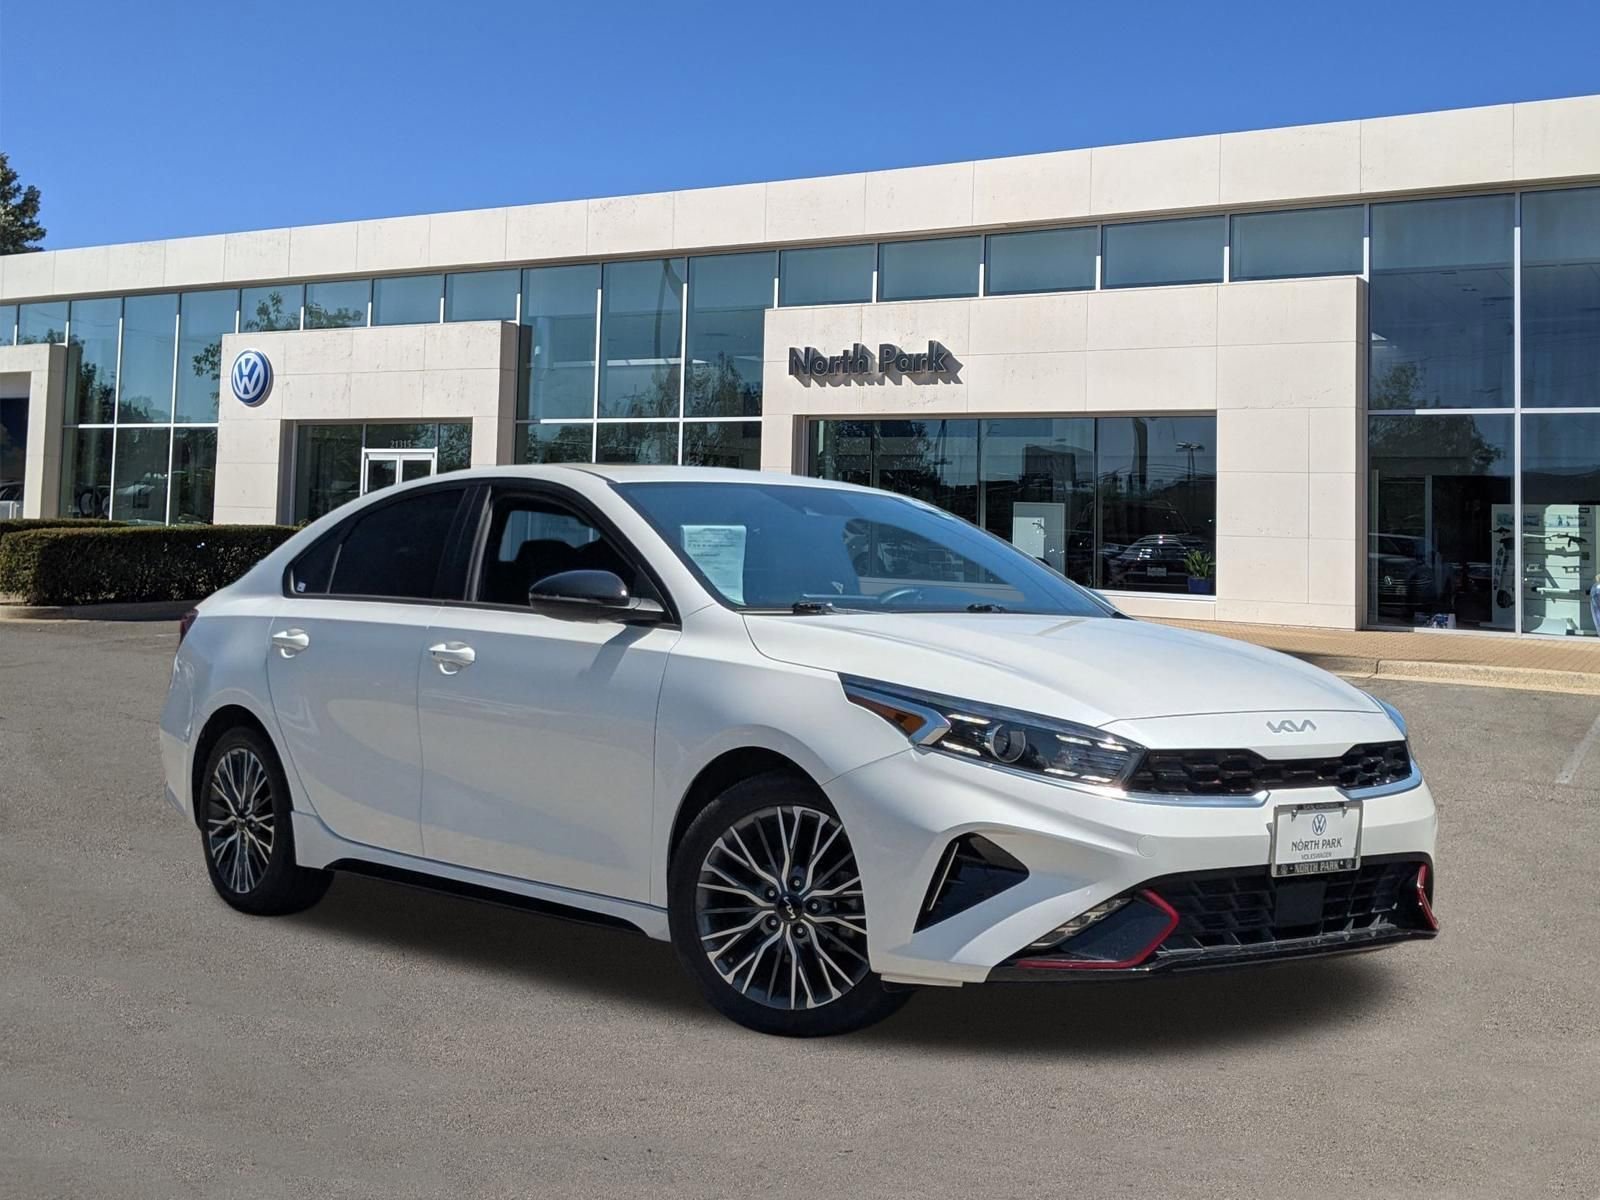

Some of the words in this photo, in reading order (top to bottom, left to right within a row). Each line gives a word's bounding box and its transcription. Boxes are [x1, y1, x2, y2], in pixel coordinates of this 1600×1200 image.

[788, 343, 872, 376] North
[878, 340, 950, 373] Park
[390, 439, 412, 449] 21315
[1291, 840, 1320, 852] NORTH
[1321, 838, 1343, 850] PARK
[1301, 852, 1332, 860] VOLKSWAGEN
[1295, 862, 1319, 873] NORTH
[1320, 860, 1339, 872] PARK
